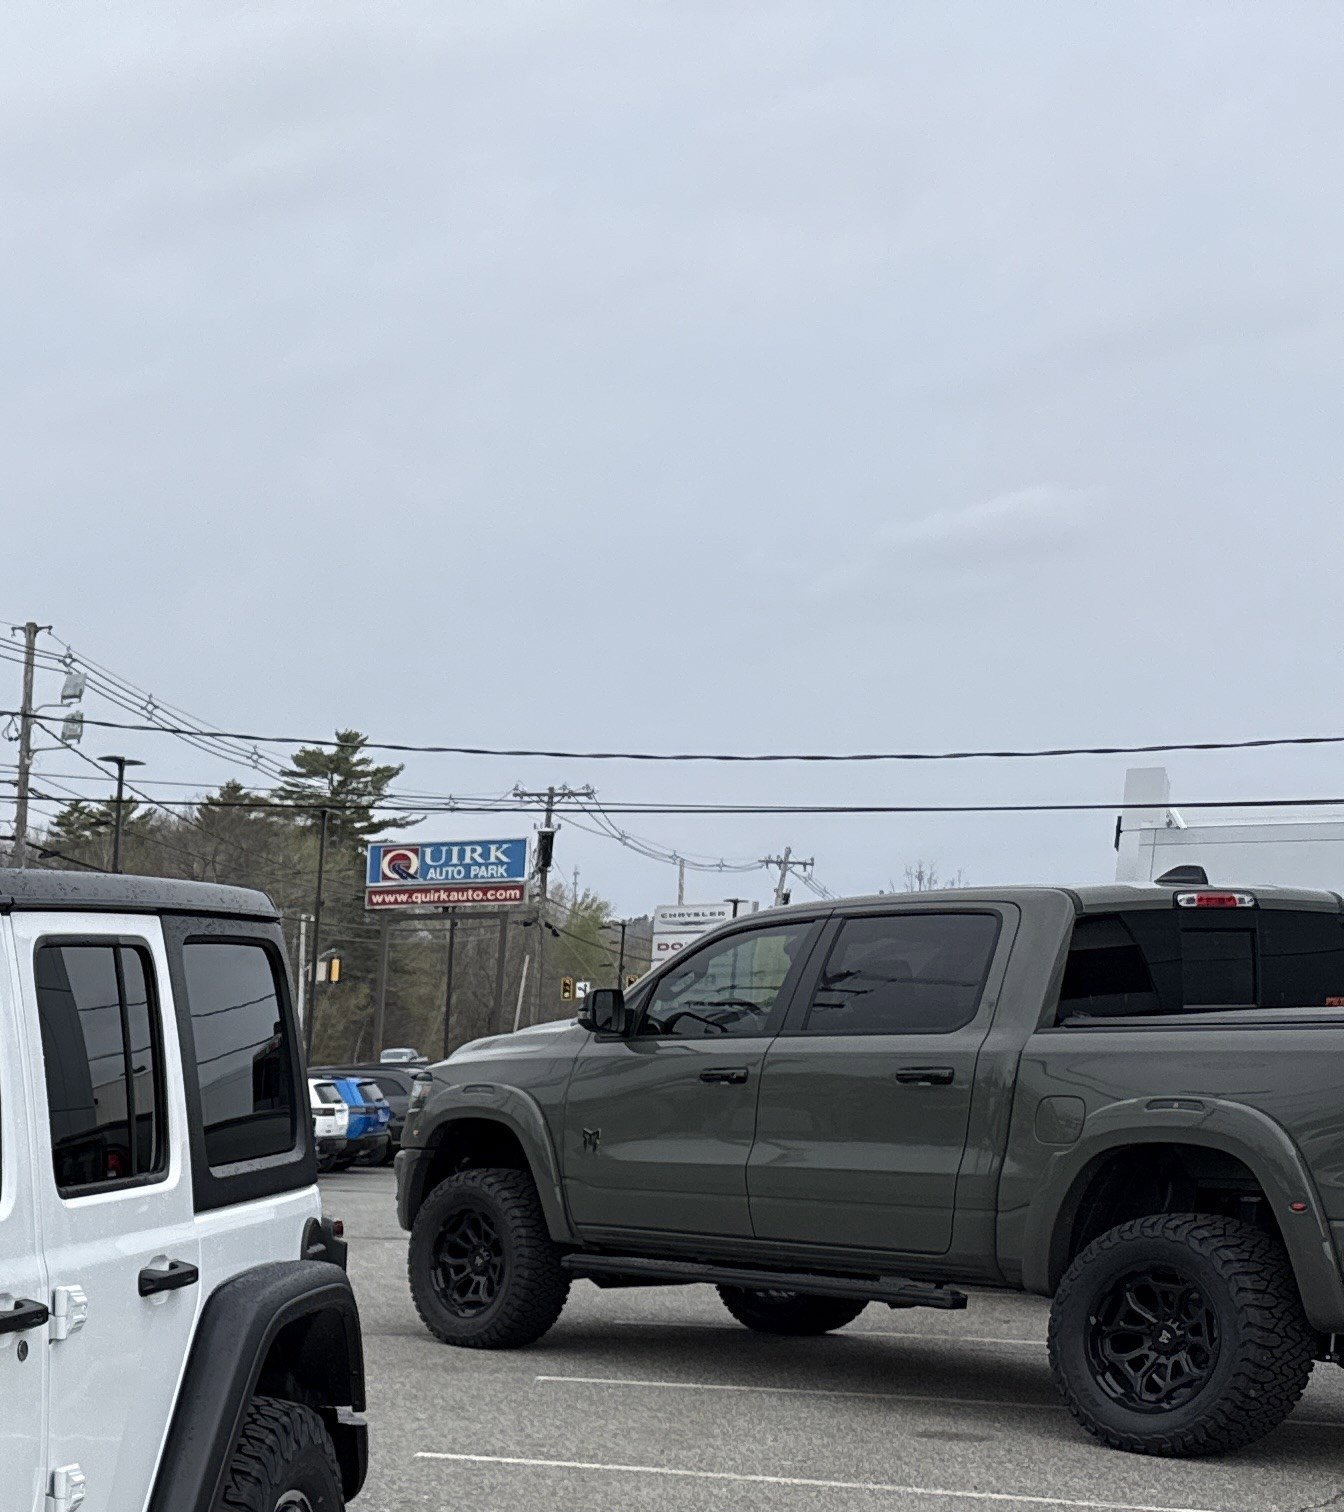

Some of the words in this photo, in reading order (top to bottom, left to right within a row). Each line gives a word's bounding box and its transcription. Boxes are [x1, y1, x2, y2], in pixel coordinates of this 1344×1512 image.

[427, 866, 465, 880] AUTO
[470, 864, 508, 878] PARK
[371, 887, 520, 904] www.quirkauto.com
